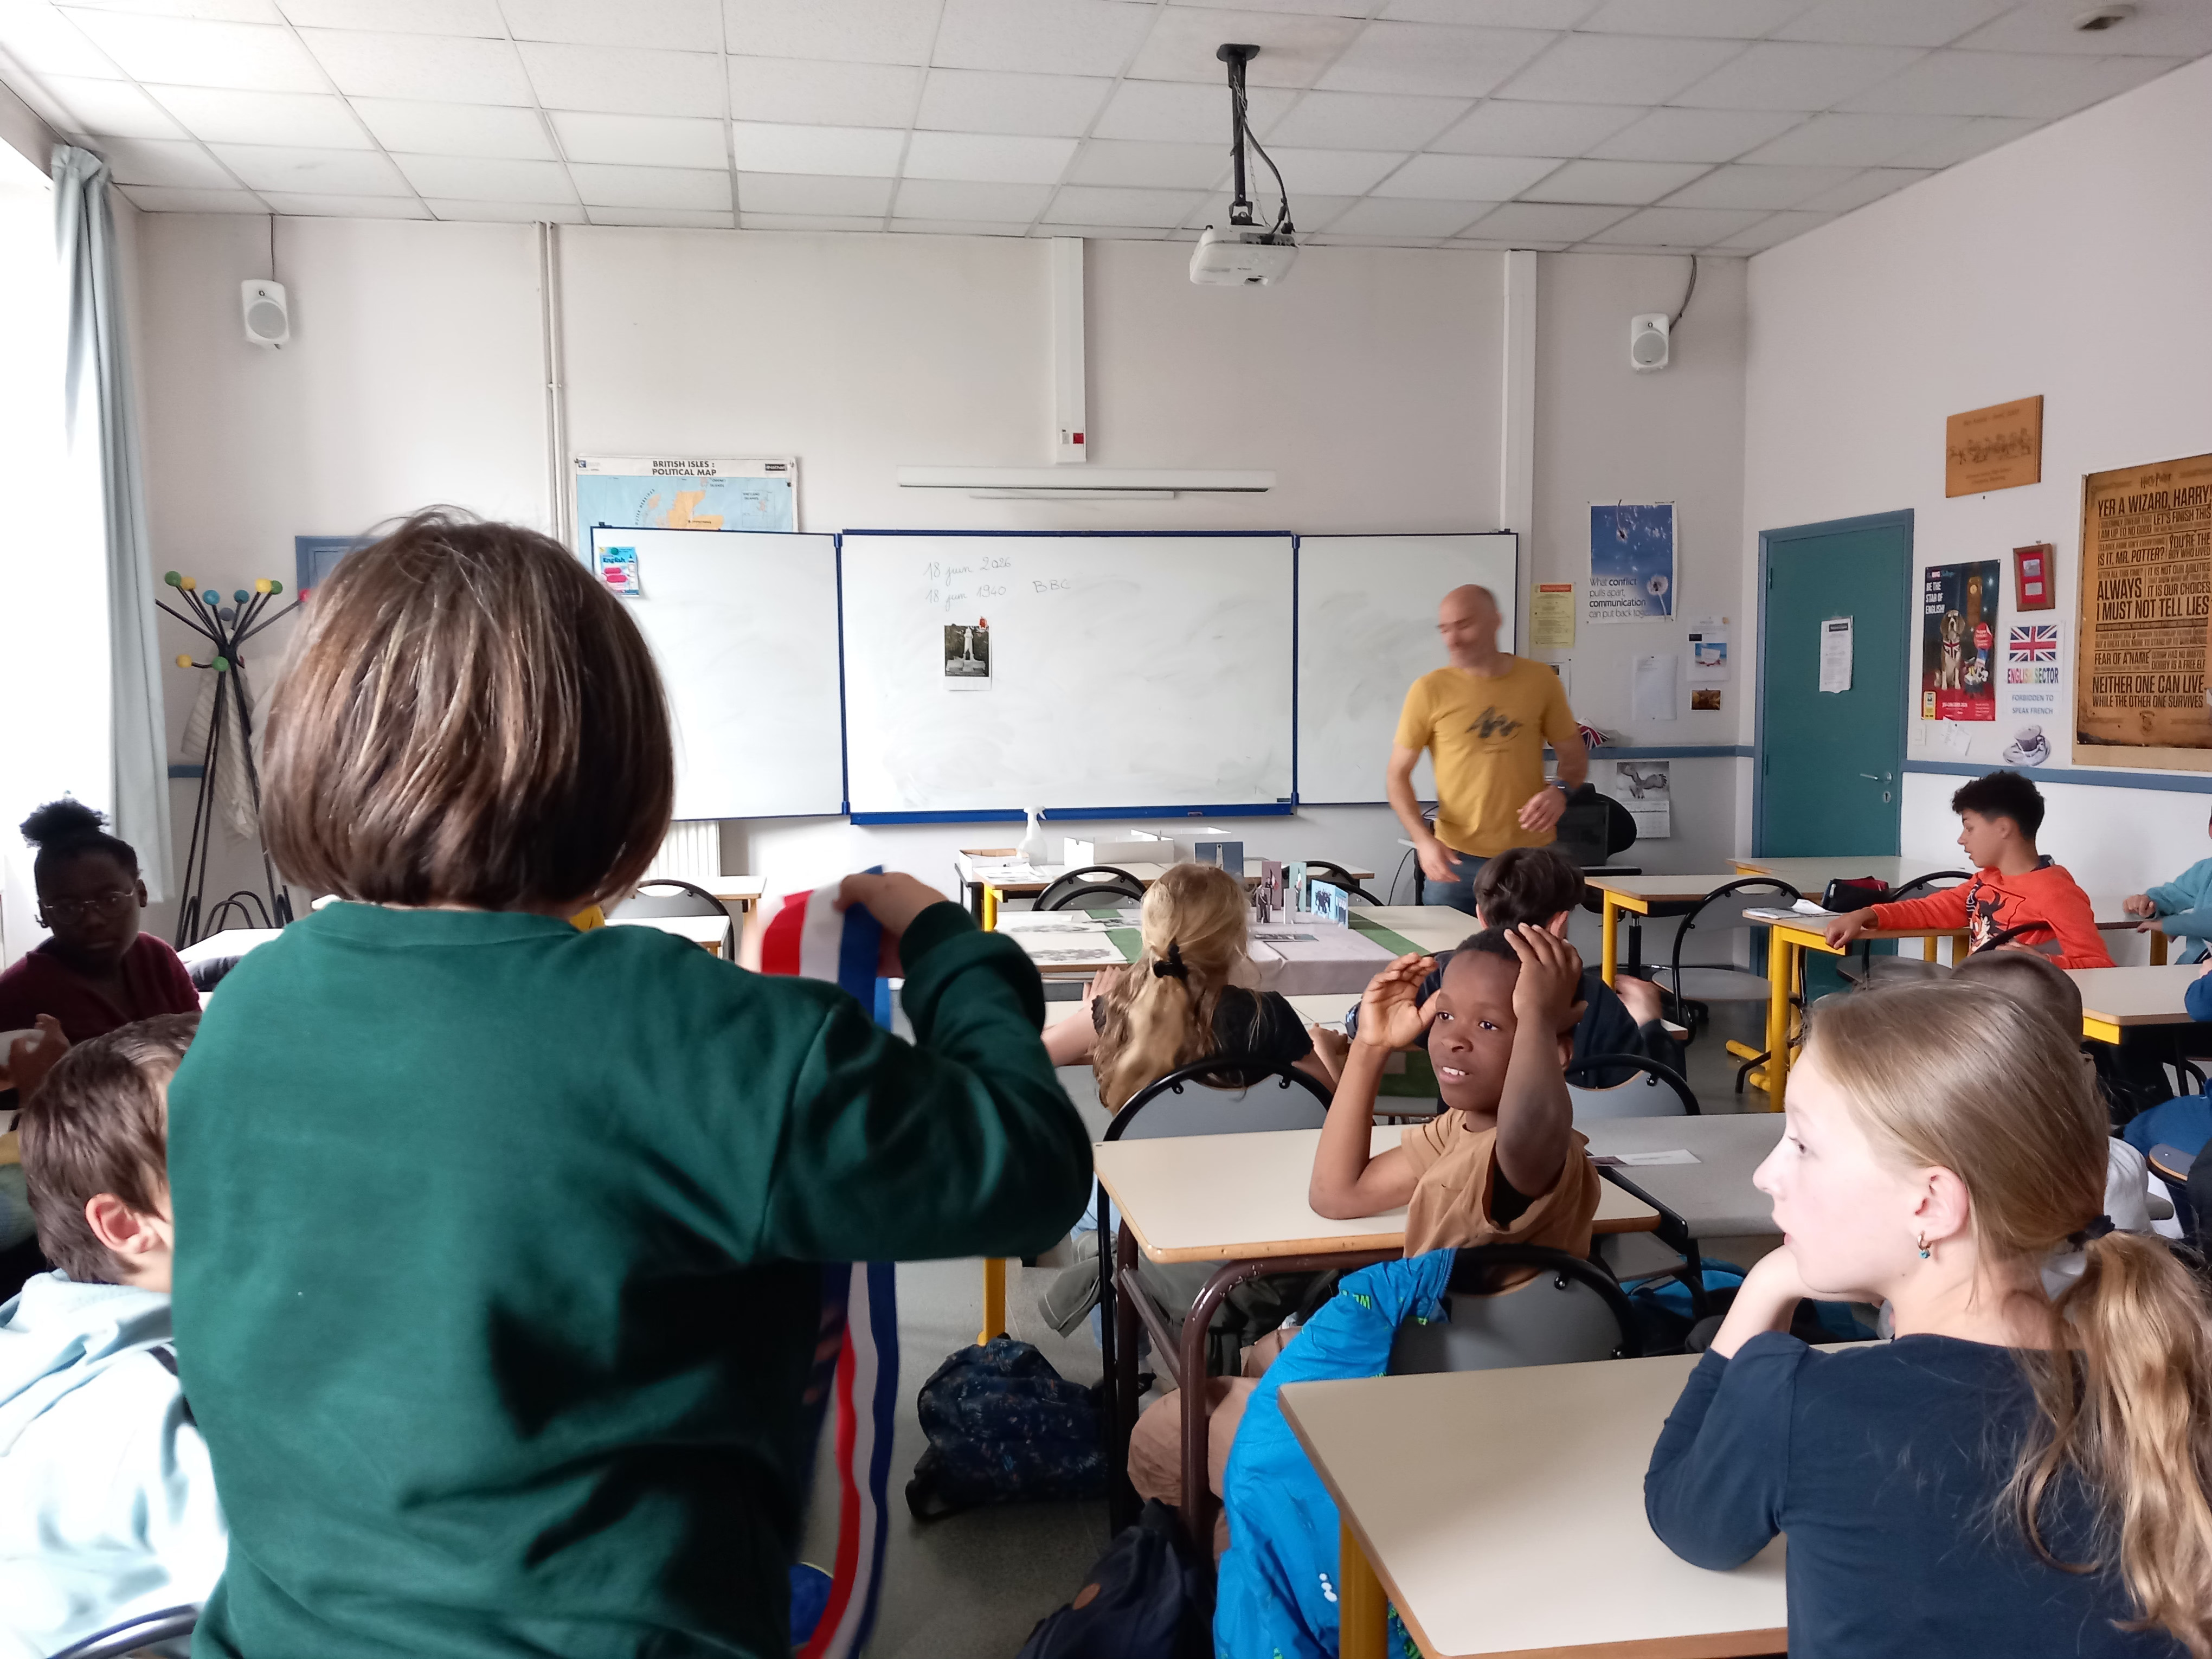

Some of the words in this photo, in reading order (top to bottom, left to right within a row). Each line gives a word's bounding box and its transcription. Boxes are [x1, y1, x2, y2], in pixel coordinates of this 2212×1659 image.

[2098, 498, 2115, 518] YER
[2118, 497, 2125, 514] A
[2172, 509, 2194, 524] FINISH
[2196, 507, 2211, 520] THIS
[2197, 532, 2211, 546] THE
[2098, 553, 2104, 566] IS
[2131, 546, 2165, 563] POTTER?
[923, 561, 941, 580] 18
[980, 556, 1011, 571] 2026
[1032, 578, 1071, 594] BBC
[1609, 577, 1637, 586] conflict
[1926, 582, 1932, 591] BE
[1933, 581, 1941, 591] THE
[2097, 576, 2142, 601] ALWAYS
[925, 589, 940, 603] 18
[976, 584, 1006, 597] 1940
[1589, 589, 1605, 599] pulls
[2147, 584, 2154, 597] IT
[2155, 584, 2162, 597] IS
[2164, 583, 2178, 596] OUR
[1589, 598, 1646, 607] communication
[1925, 593, 1937, 603] STAR
[1938, 593, 1944, 602] OF
[1603, 609, 1614, 619] put
[1616, 608, 1631, 618] back
[2096, 602, 2100, 621] I
[2102, 600, 2132, 621] MUST
[2134, 598, 2156, 619] NOT
[2159, 596, 2183, 618] TELL
[2186, 595, 2210, 616] LIES
[2094, 652, 2111, 665] FEAR
[2113, 652, 2121, 665] OF
[2123, 652, 2127, 665] A
[2129, 651, 2150, 665] NAME
[2007, 667, 2033, 684] ENGLIS
[2034, 667, 2059, 684] SECTOR
[2092, 676, 2132, 693] NEITHER
[2135, 675, 2155, 693] ONE
[2158, 674, 2180, 693] CAN
[2183, 674, 2204, 693] LIVE
[2092, 695, 2113, 708] WHILE
[2115, 695, 2127, 708] THE
[2129, 695, 2151, 708] OTHER
[2153, 695, 2166, 708] ONE
[2168, 695, 2203, 708] SURVIVES
